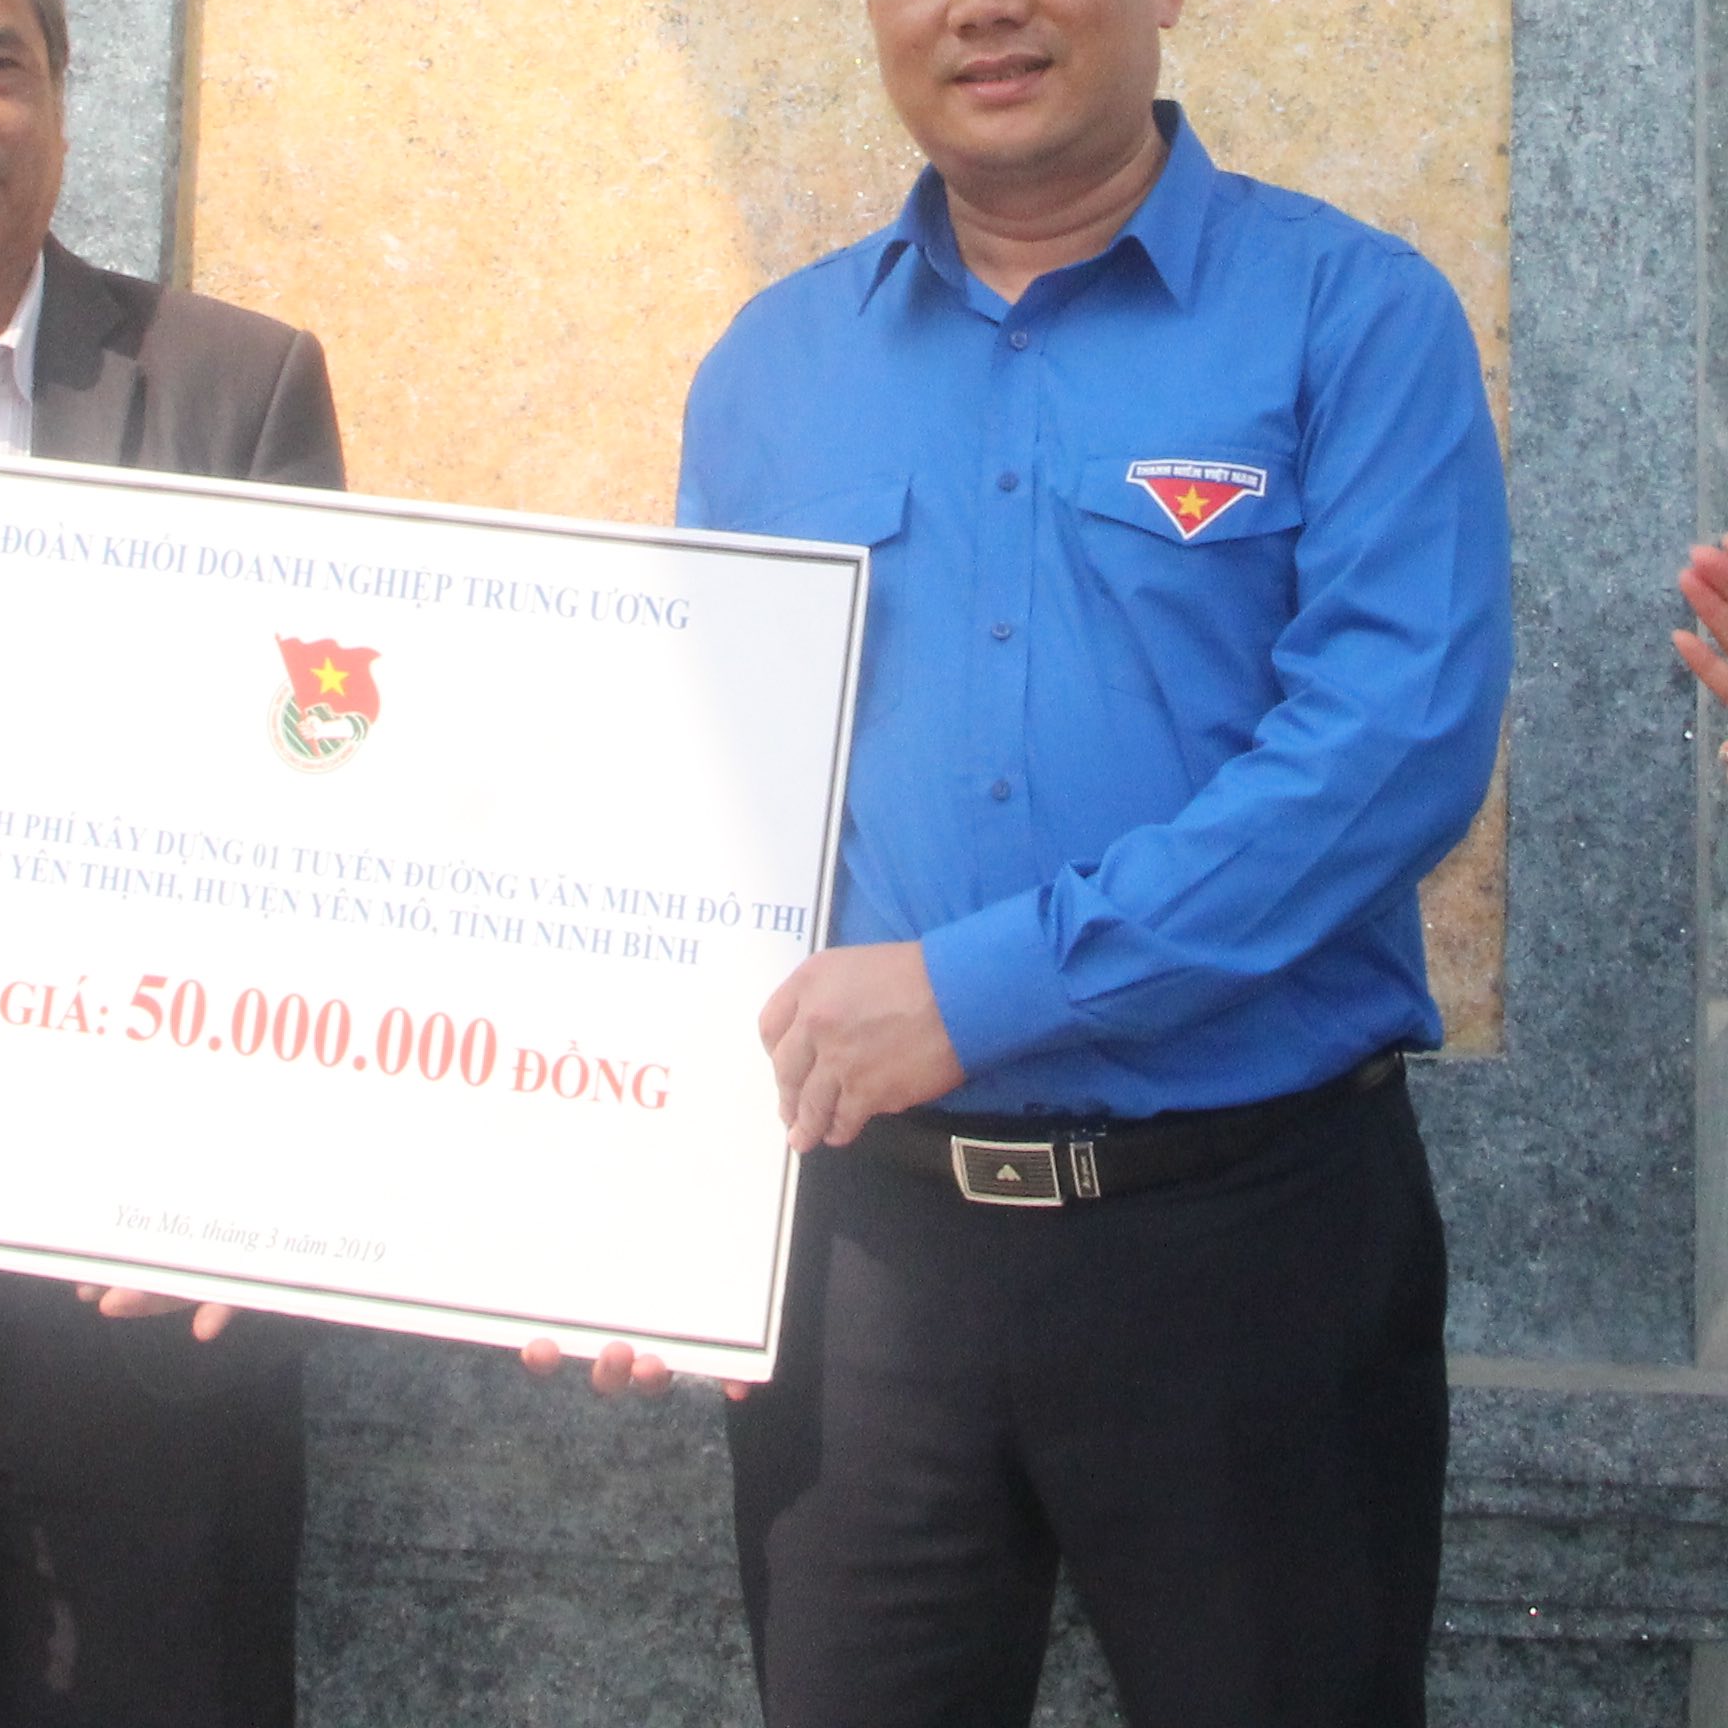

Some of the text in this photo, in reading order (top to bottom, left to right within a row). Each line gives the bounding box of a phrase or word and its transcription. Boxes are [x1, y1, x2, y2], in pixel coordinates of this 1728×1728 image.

[0, 523, 94, 562] ĐOÀN
[196, 546, 315, 590] DOANH
[325, 561, 453, 610] NGHIỆP
[463, 577, 578, 620] TRUNG
[589, 587, 691, 632] ƯƠNG
[10, 849, 69, 886] YÊN
[80, 862, 183, 902] THỊNH,
[311, 888, 373, 924] YÊN
[380, 900, 439, 935] MÔ,
[532, 919, 612, 956] NINH
[623, 927, 701, 965] BÌNH
[23, 810, 77, 845] PHÍ
[84, 815, 148, 853] XÂY
[155, 830, 244, 865] DỰNG
[252, 842, 281, 871] 01
[529, 874, 590, 909] VĂN
[601, 885, 687, 921] MINH
[697, 891, 742, 927] ĐÔ
[752, 902, 807, 941] THỊ
[125, 974, 497, 1088] 50.000.000
[513, 1038, 671, 1111] ĐỒNG
[201, 1219, 259, 1251] tháng
[266, 1227, 279, 1249] 3
[283, 1232, 328, 1258] năm
[332, 1235, 386, 1264] 2019
